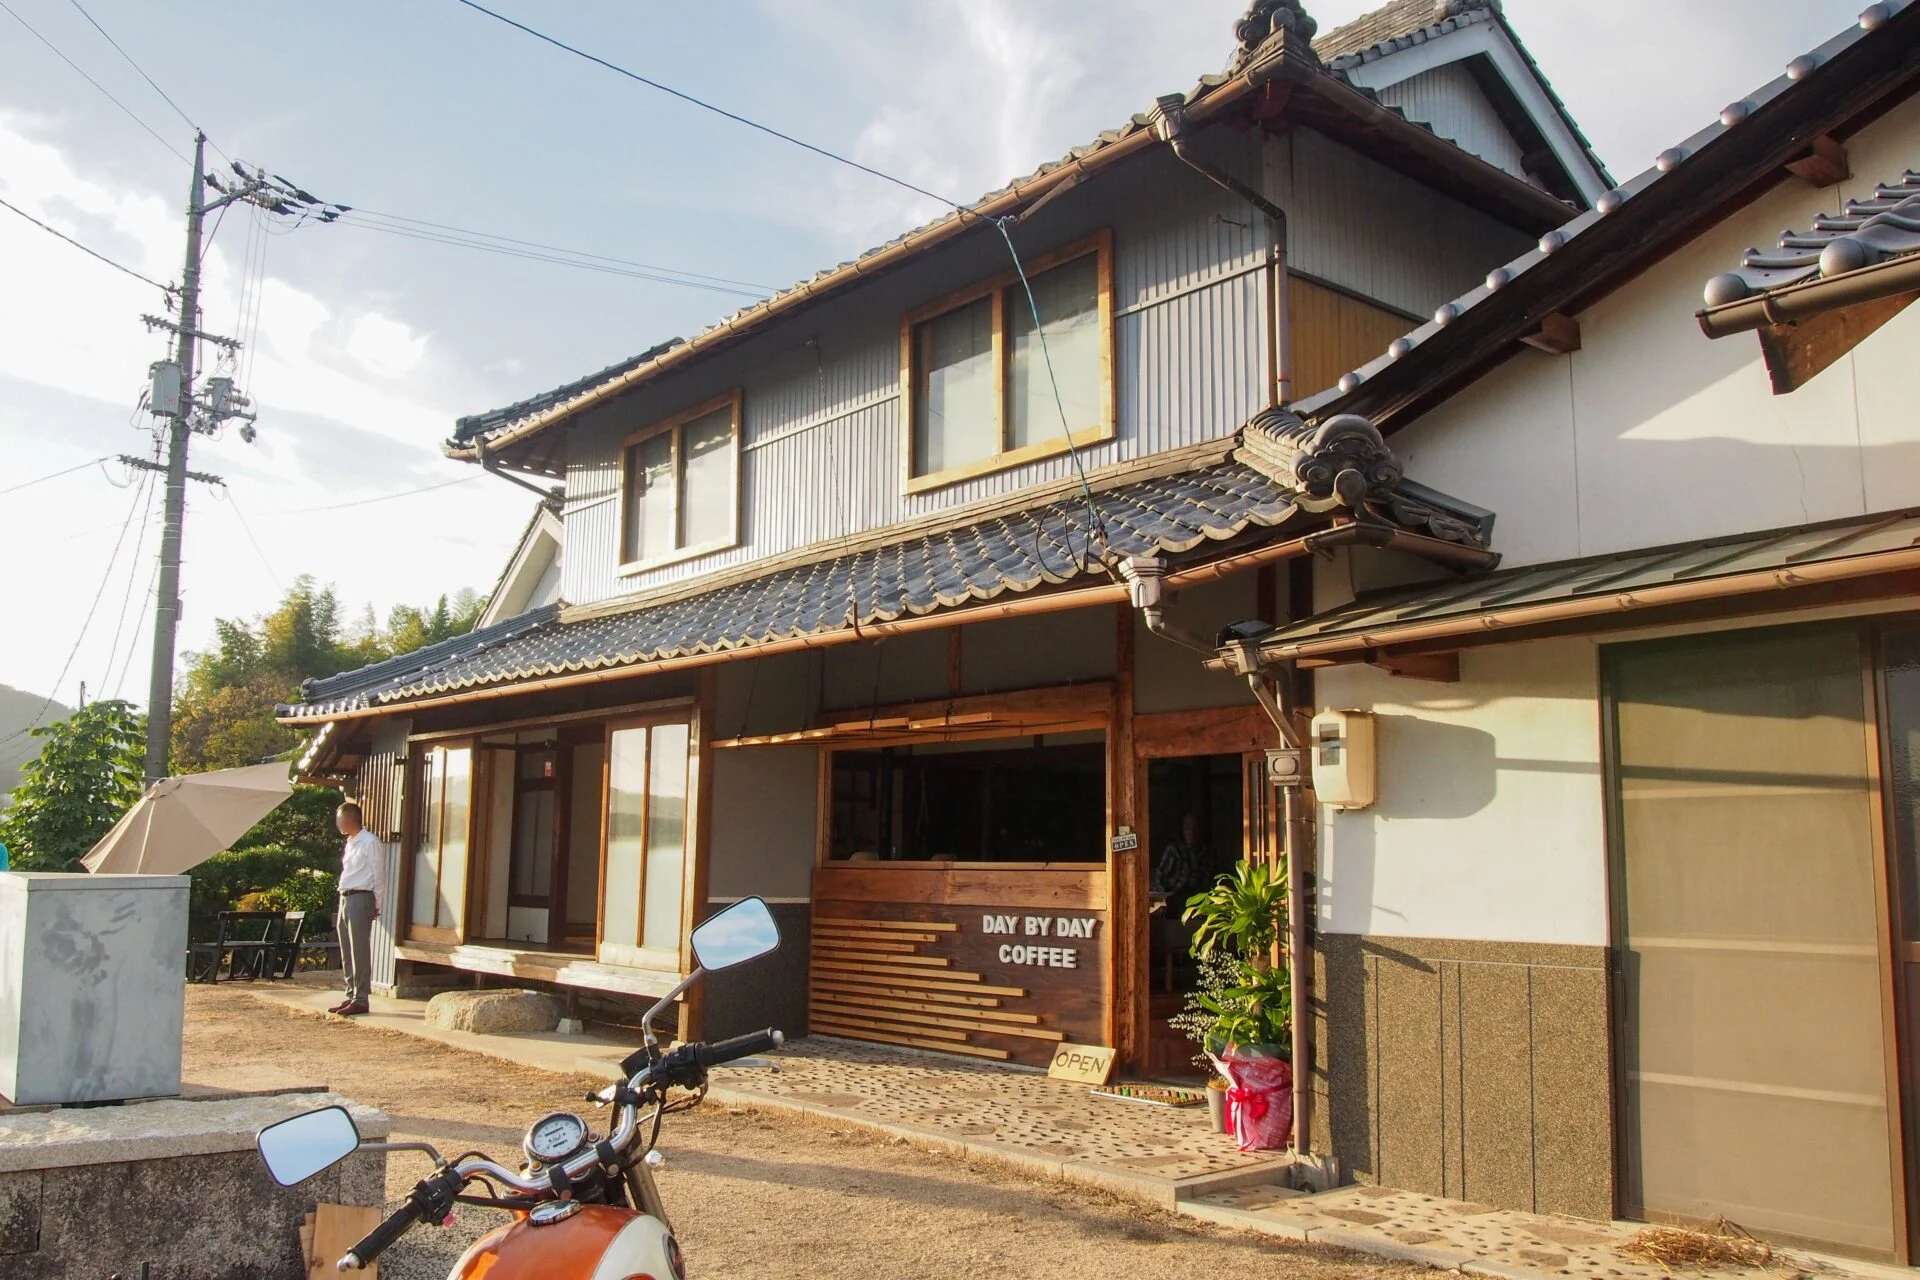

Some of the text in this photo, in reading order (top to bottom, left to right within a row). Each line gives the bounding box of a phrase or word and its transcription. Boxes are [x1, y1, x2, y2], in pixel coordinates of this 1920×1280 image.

[1114, 839, 1135, 849] OPEN
[982, 914, 1096, 938] DAY BY DAY
[999, 944, 1077, 968] COFFEE
[1055, 1051, 1106, 1075] OPEN
